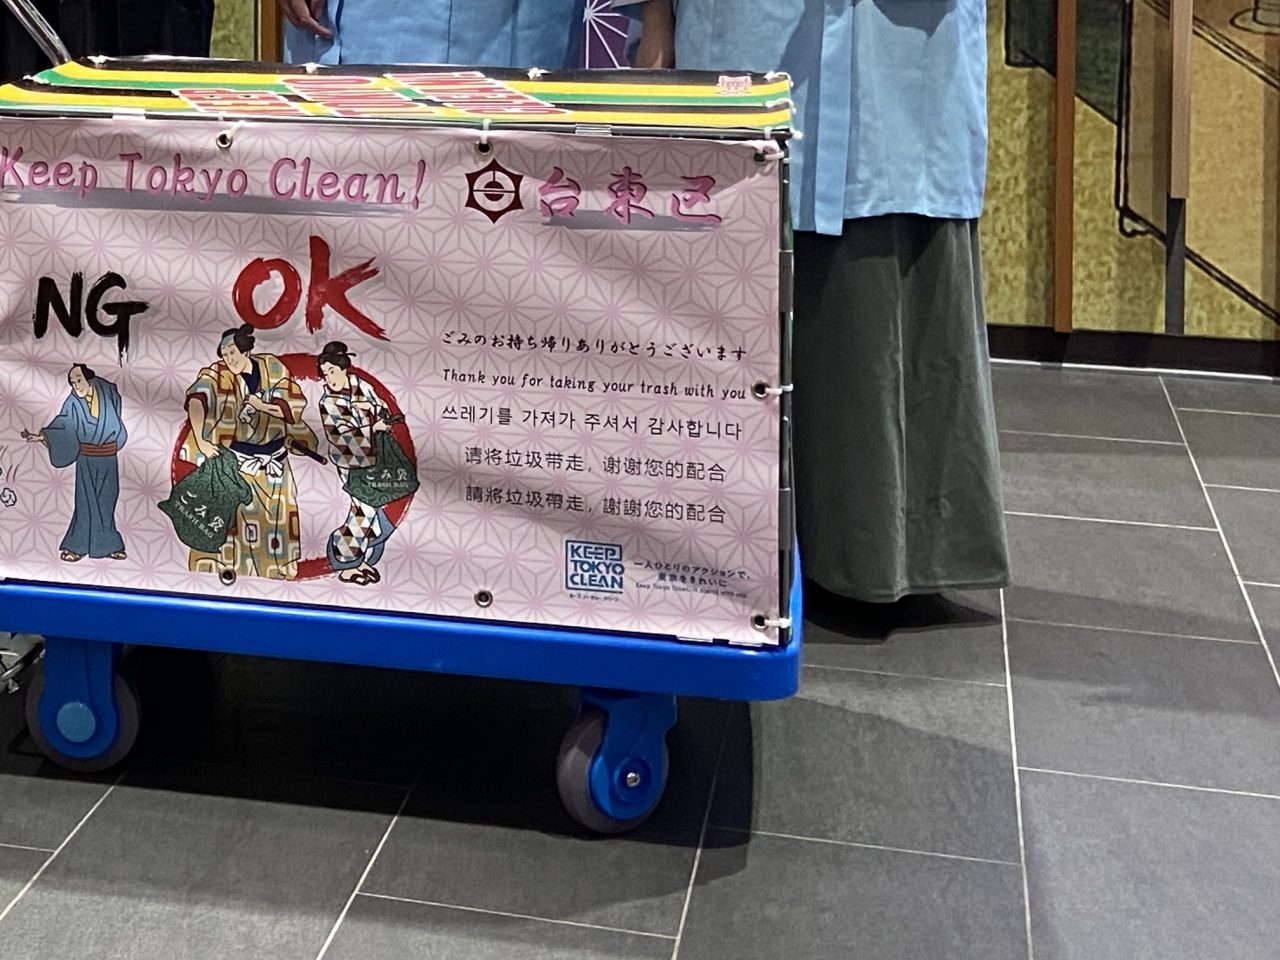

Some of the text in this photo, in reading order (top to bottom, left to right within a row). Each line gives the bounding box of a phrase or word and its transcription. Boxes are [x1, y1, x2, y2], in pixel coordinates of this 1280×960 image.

[119, 152, 249, 201] Tokyo
[269, 157, 427, 209] Clean!
[232, 235, 390, 341] OK
[33, 270, 150, 365] NG
[442, 331, 748, 361] ごみのお持ち帰りありがとうございます
[443, 368, 747, 400] Thank you for taking your trash with you
[441, 404, 743, 441] 쓰레기를 가져가 주셔서 감사합니다
[570, 544, 618, 561] KEEP
[570, 559, 625, 575] TOKYO
[570, 573, 624, 589] CLEAN
[634, 560, 751, 580] 一人ひとりのアクションで、
